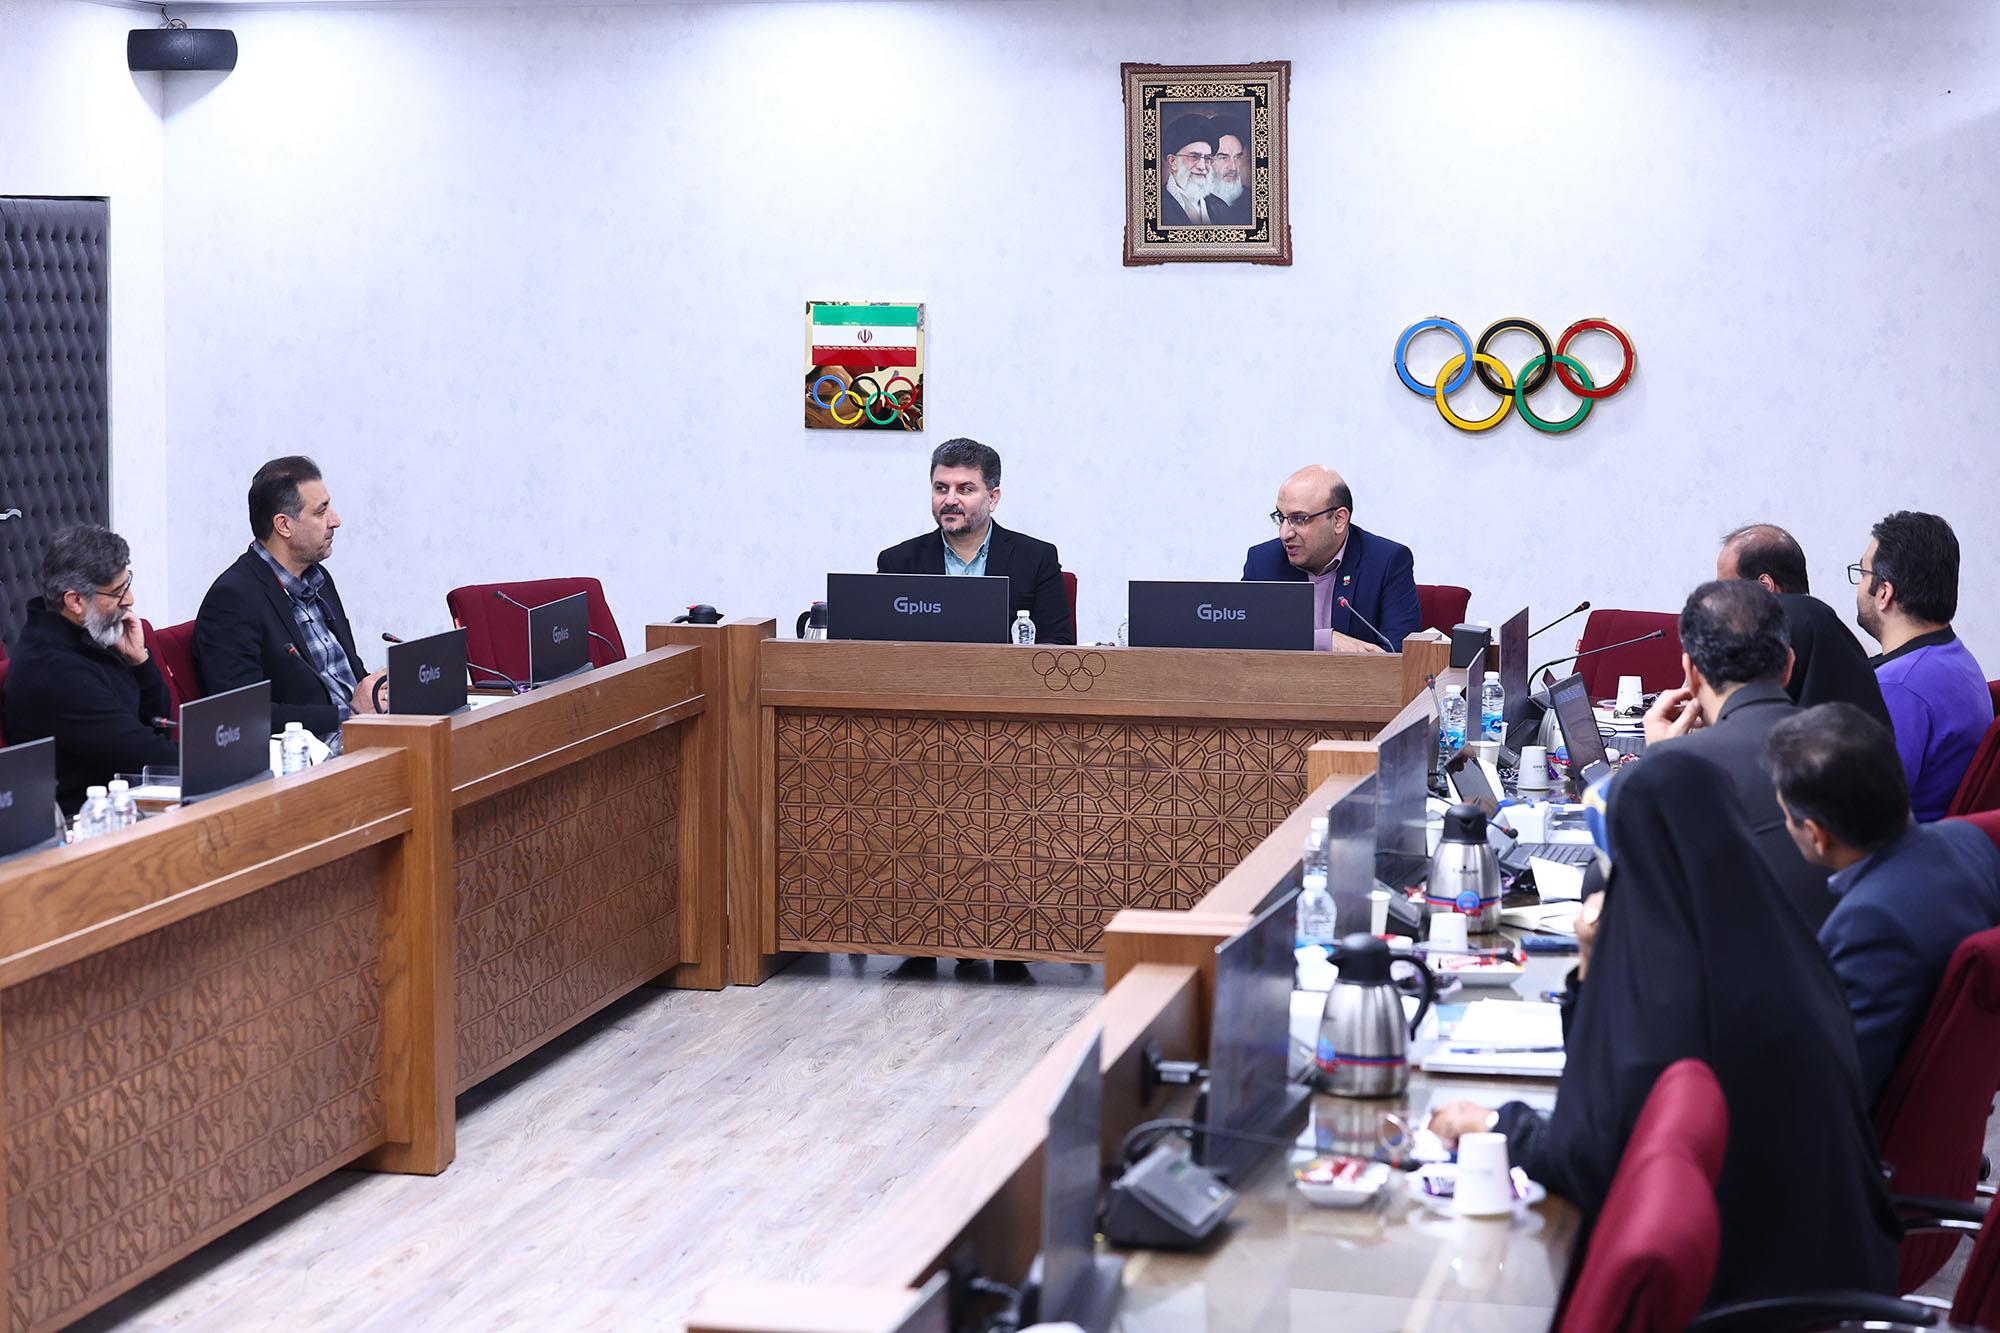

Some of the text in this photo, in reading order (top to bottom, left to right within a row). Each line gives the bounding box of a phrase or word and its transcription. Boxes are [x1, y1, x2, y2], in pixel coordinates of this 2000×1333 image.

[894, 596, 942, 615] Gplus
[1197, 603, 1247, 622] Gplus
[552, 625, 569, 645] Gplus
[419, 664, 441, 685] Gplus
[215, 724, 241, 748] Gplus
